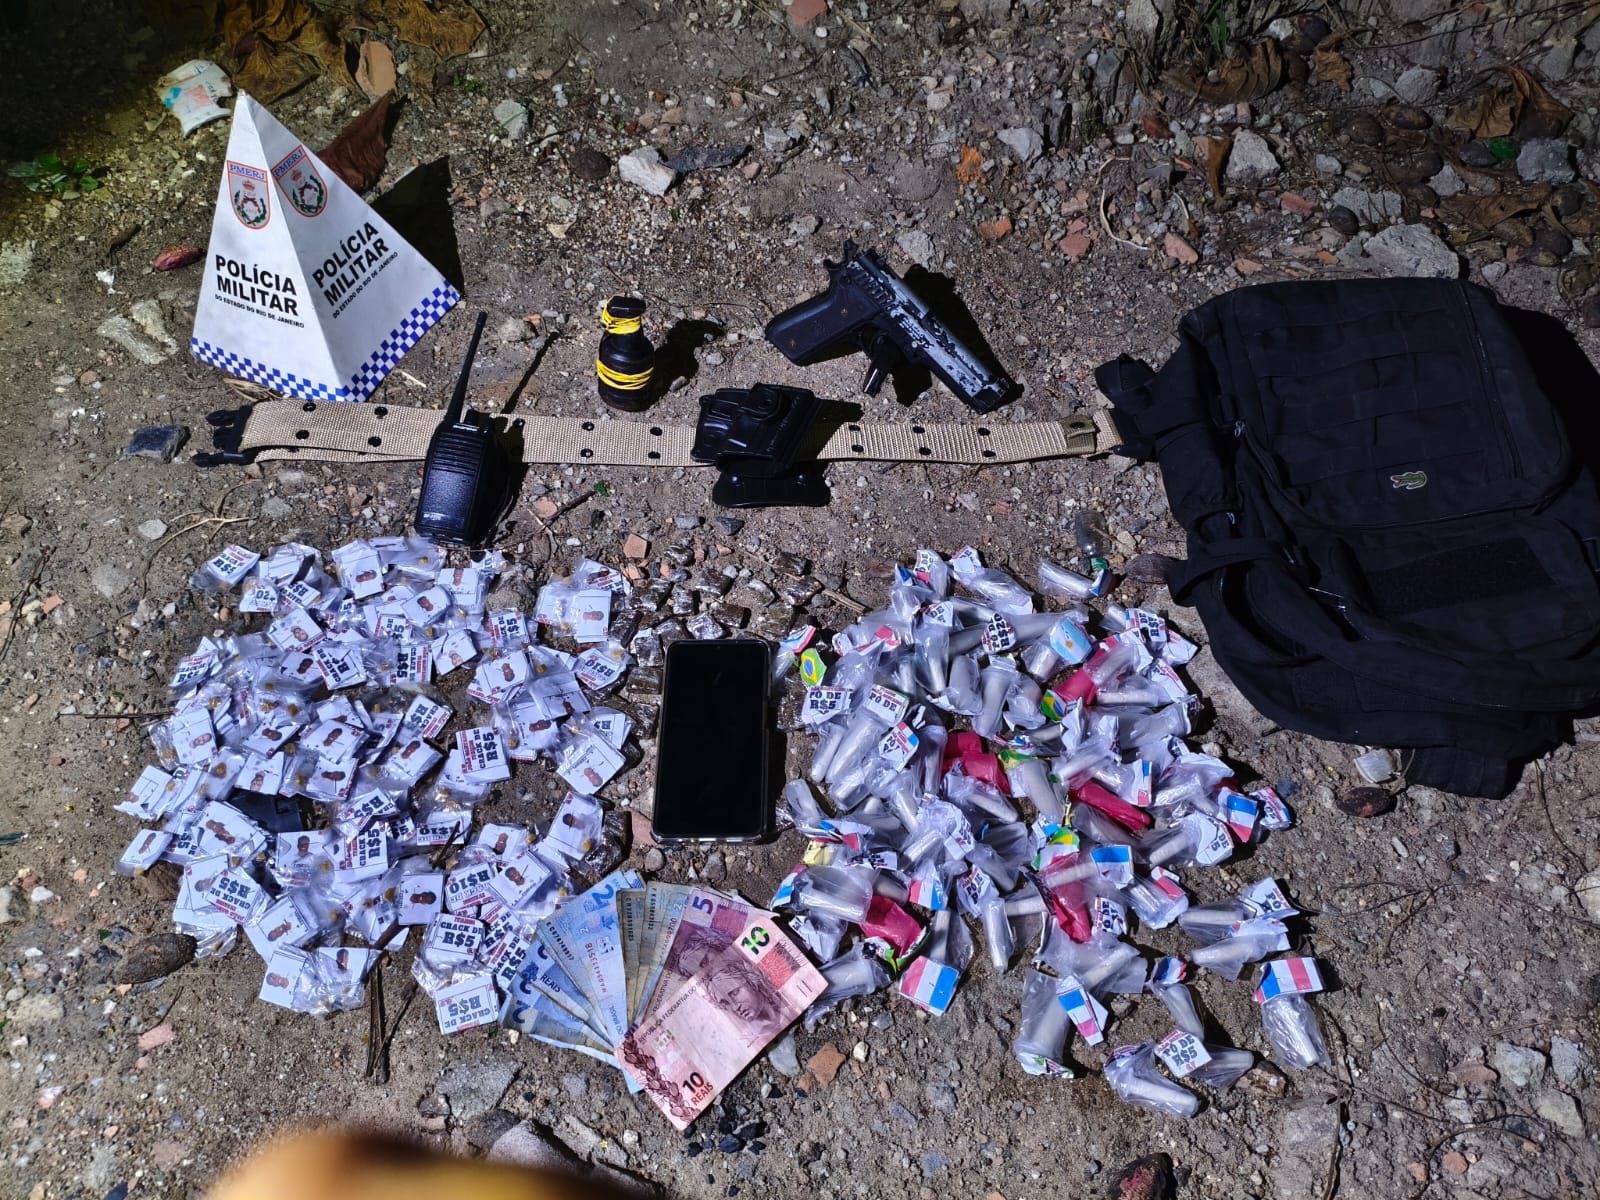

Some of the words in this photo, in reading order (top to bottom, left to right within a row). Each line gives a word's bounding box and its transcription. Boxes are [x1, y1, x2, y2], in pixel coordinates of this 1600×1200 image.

[230, 164, 264, 179] PMERJ
[275, 150, 303, 176] PMERJ
[312, 222, 379, 288] POLÍCIA
[215, 254, 297, 295] POLÍCIA
[324, 238, 389, 306] MILITAR
[217, 274, 298, 317] MILITAR
[333, 310, 340, 318] DO
[339, 292, 357, 311] ESTADO
[356, 285, 363, 294] DO
[363, 277, 371, 287] RIO
[371, 270, 378, 278] DE
[379, 252, 398, 272] JANEIRO
[223, 297, 246, 309] ESTADO
[247, 305, 254, 313] DO
[278, 316, 304, 328] JANEIRO
[397, 653, 408, 677] R$5
[585, 659, 614, 676] R$10
[810, 699, 836, 709] R$5
[883, 700, 897, 711] DE
[472, 727, 480, 740] DE
[475, 742, 488, 768] CRACK
[480, 732, 501, 761] R$5
[359, 839, 367, 865] CRACK
[367, 827, 383, 857] R$5
[210, 888, 221, 896] DE
[219, 874, 250, 898] R$5
[446, 870, 489, 891] R$10
[222, 893, 250, 909] CRACK
[591, 883, 615, 907] 2
[693, 898, 714, 915] 5
[440, 922, 469, 932] CRACK
[500, 912, 511, 922] DE
[443, 932, 475, 947] R$5
[509, 934, 520, 949] DE
[741, 925, 771, 956] 10
[499, 948, 526, 980] R$5
[445, 996, 481, 1016] R$5
[457, 1008, 490, 1023] CRACK
[662, 994, 688, 1019] FEDERATIVA
[444, 1019, 457, 1027] DE
[1177, 1033, 1194, 1048] DE
[1172, 1046, 1197, 1065] R$5
[682, 1071, 705, 1096] 10
[690, 1082, 714, 1107] REAIS
